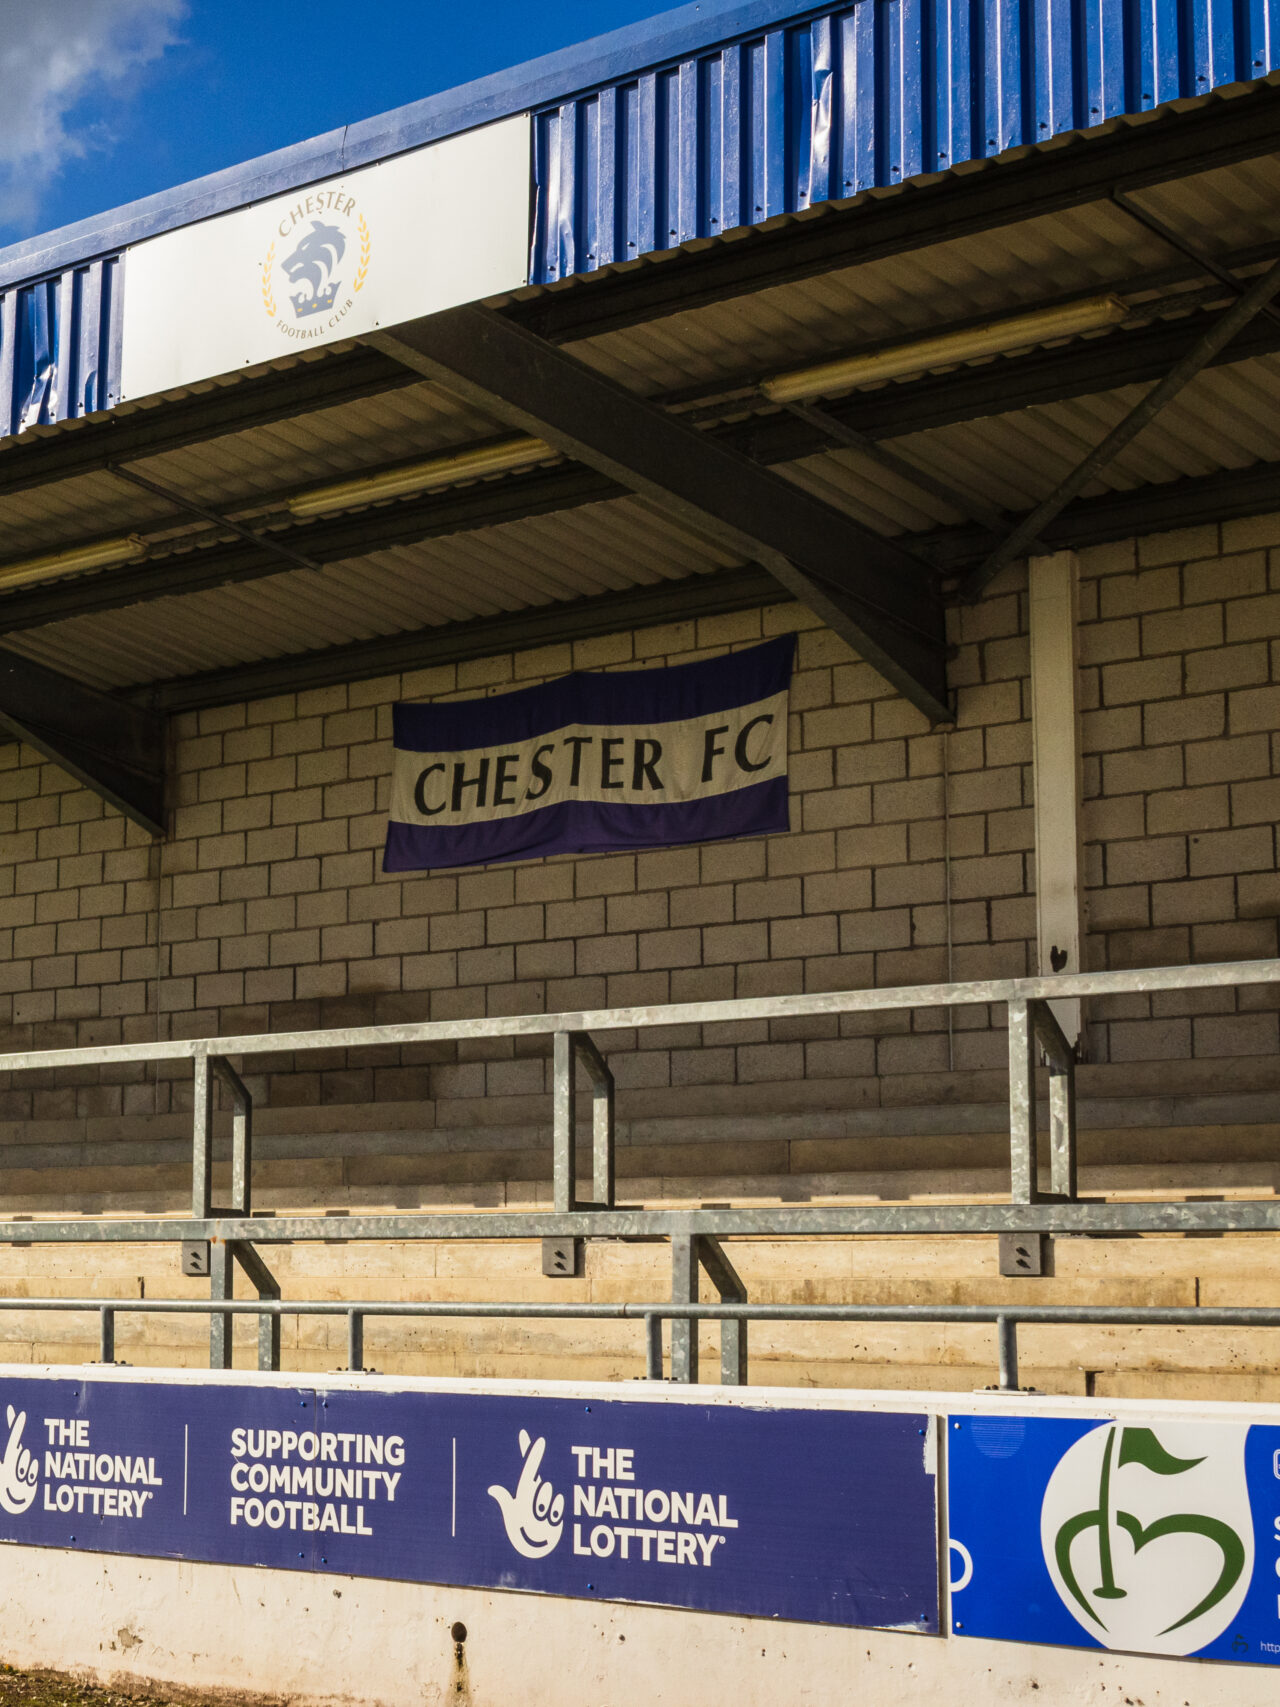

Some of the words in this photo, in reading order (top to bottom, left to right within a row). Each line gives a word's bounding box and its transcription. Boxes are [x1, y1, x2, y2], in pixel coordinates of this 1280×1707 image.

[278, 191, 356, 237] CHESTER
[276, 319, 325, 340] FOOTBALL
[328, 298, 353, 328] CLUB
[413, 736, 664, 816] CHESTER
[700, 714, 774, 783] FC
[44, 1418, 90, 1448] THE
[230, 1427, 406, 1466] SUPPORTING
[44, 1451, 163, 1485] NATIONAL
[230, 1462, 402, 1501] COMMUNITY
[571, 1446, 635, 1481] THE
[230, 1496, 373, 1535] FOOTBALL
[573, 1485, 739, 1529] NATIONAL
